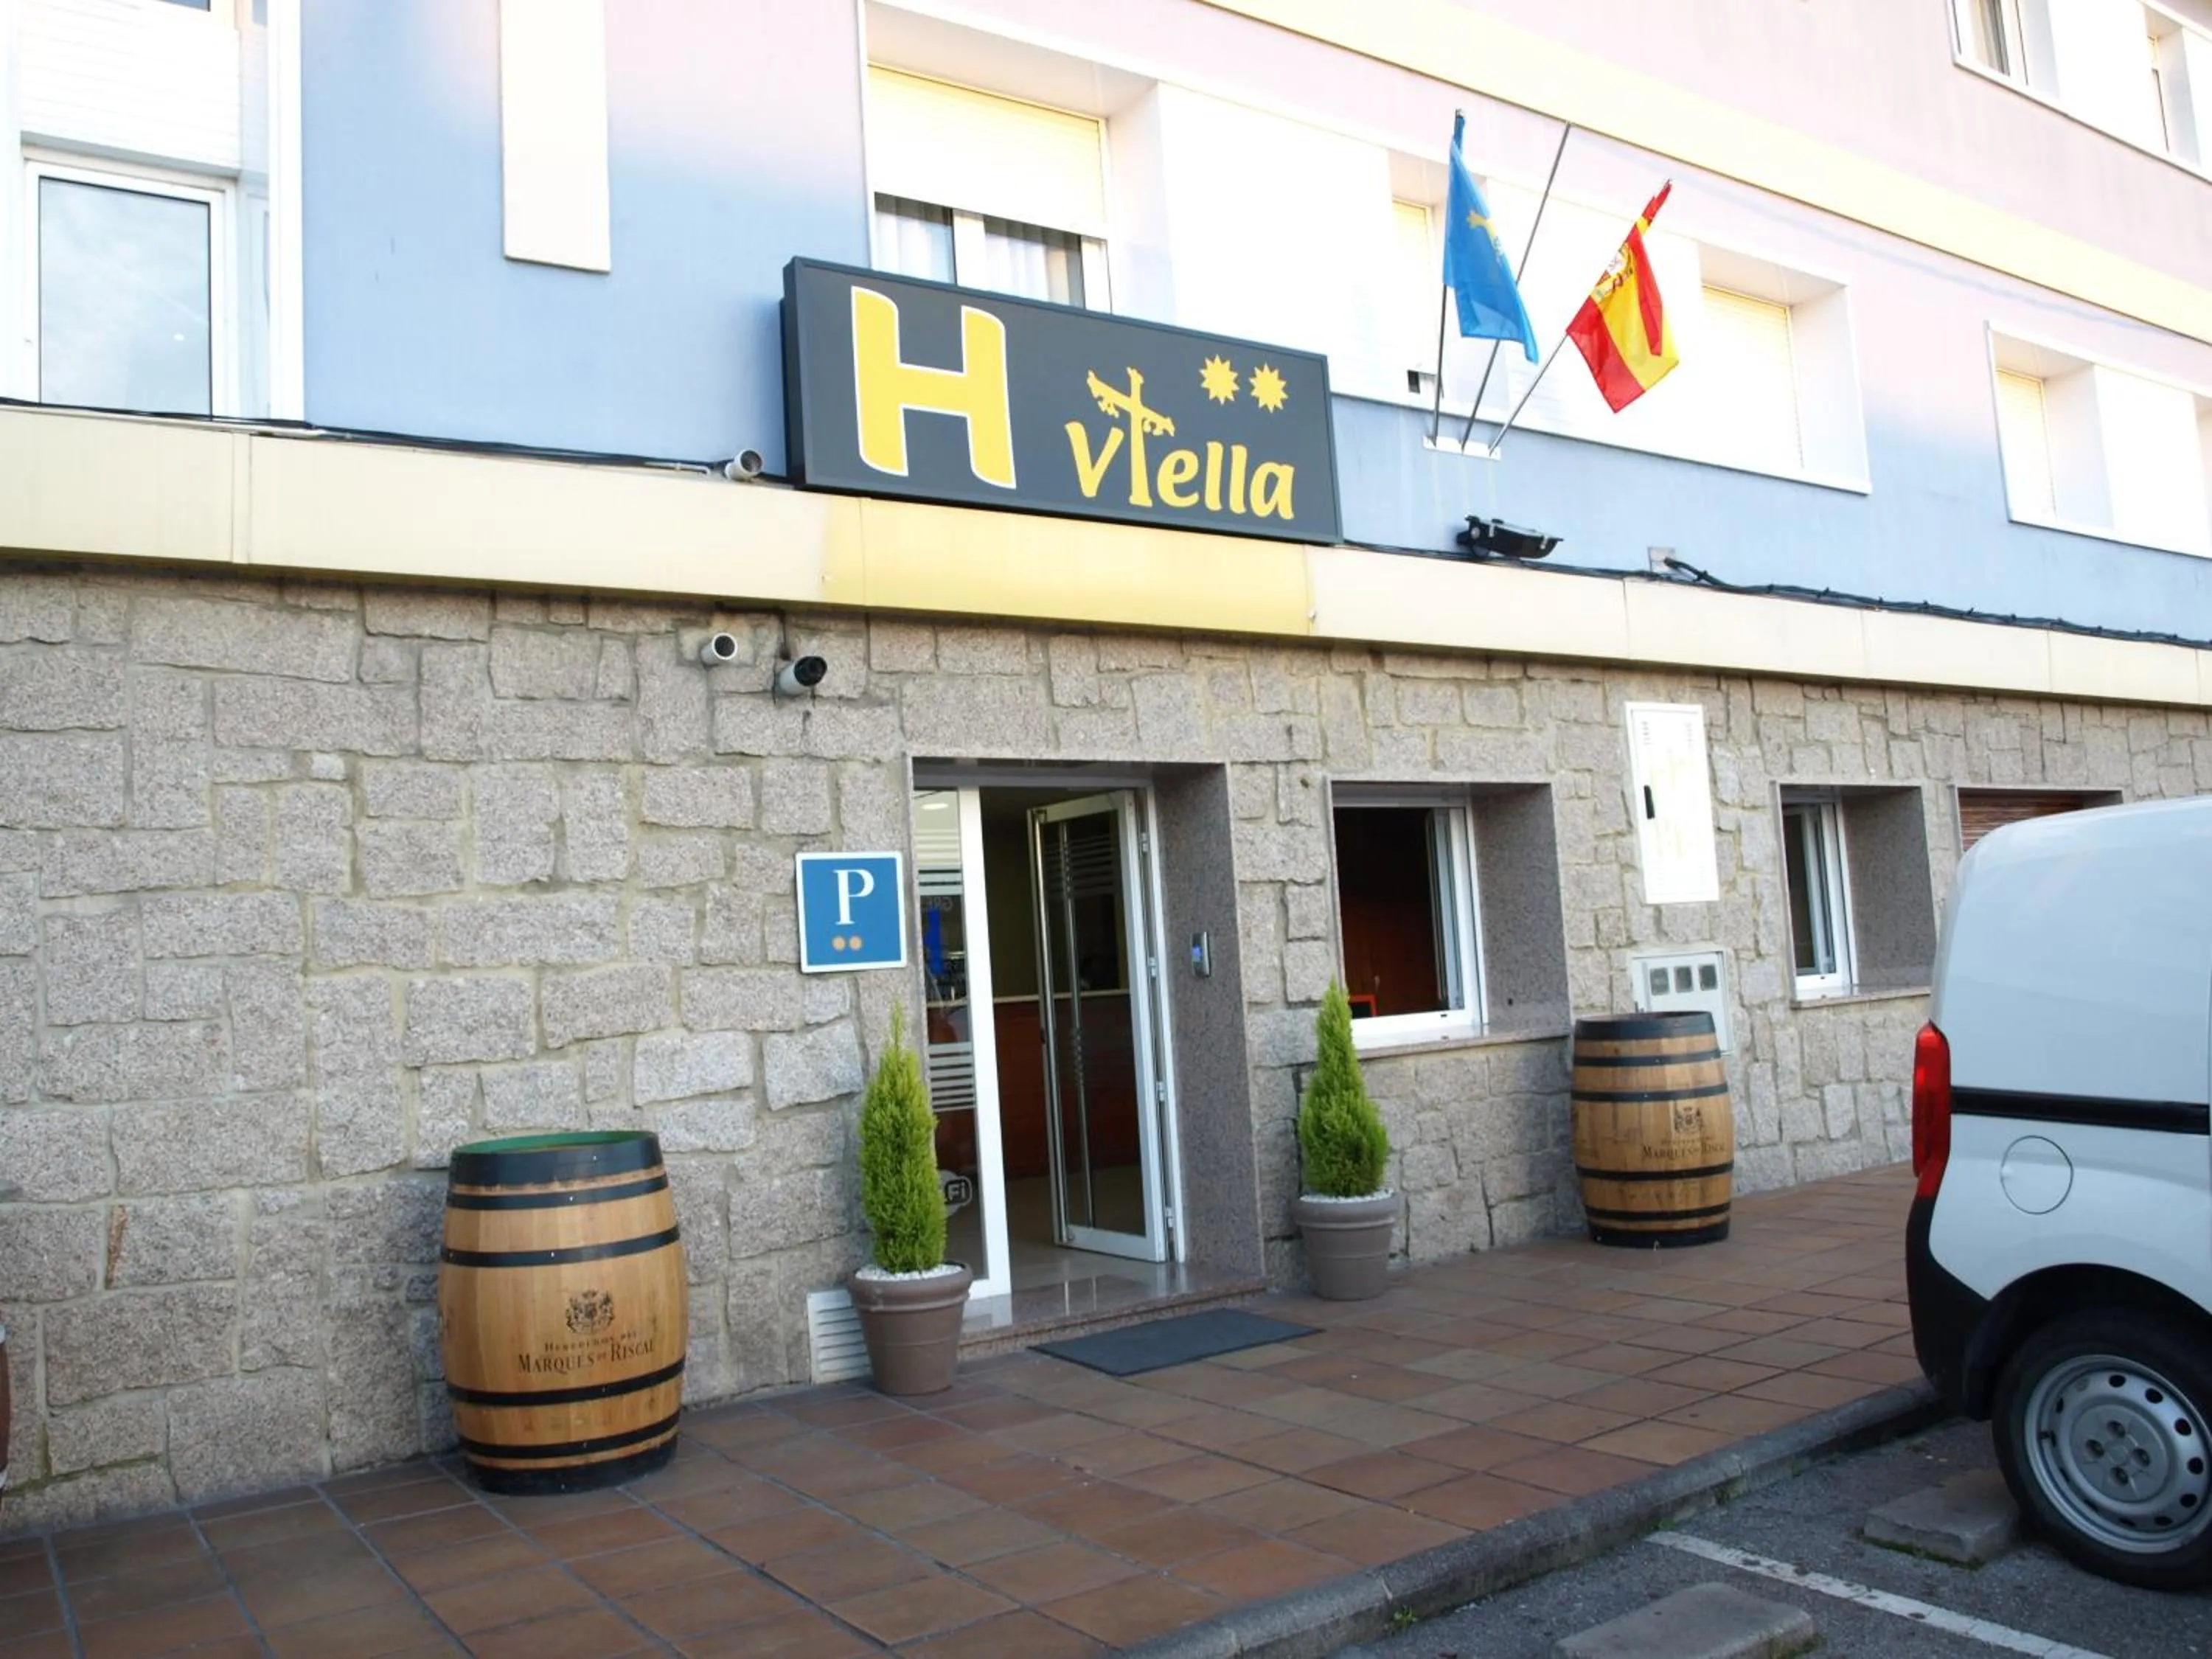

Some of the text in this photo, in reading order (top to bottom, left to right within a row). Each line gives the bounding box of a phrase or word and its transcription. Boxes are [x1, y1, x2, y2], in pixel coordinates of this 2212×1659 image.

[850, 285, 1017, 490] H
[832, 869, 875, 926] P
[611, 1338, 655, 1363] RISCAL
